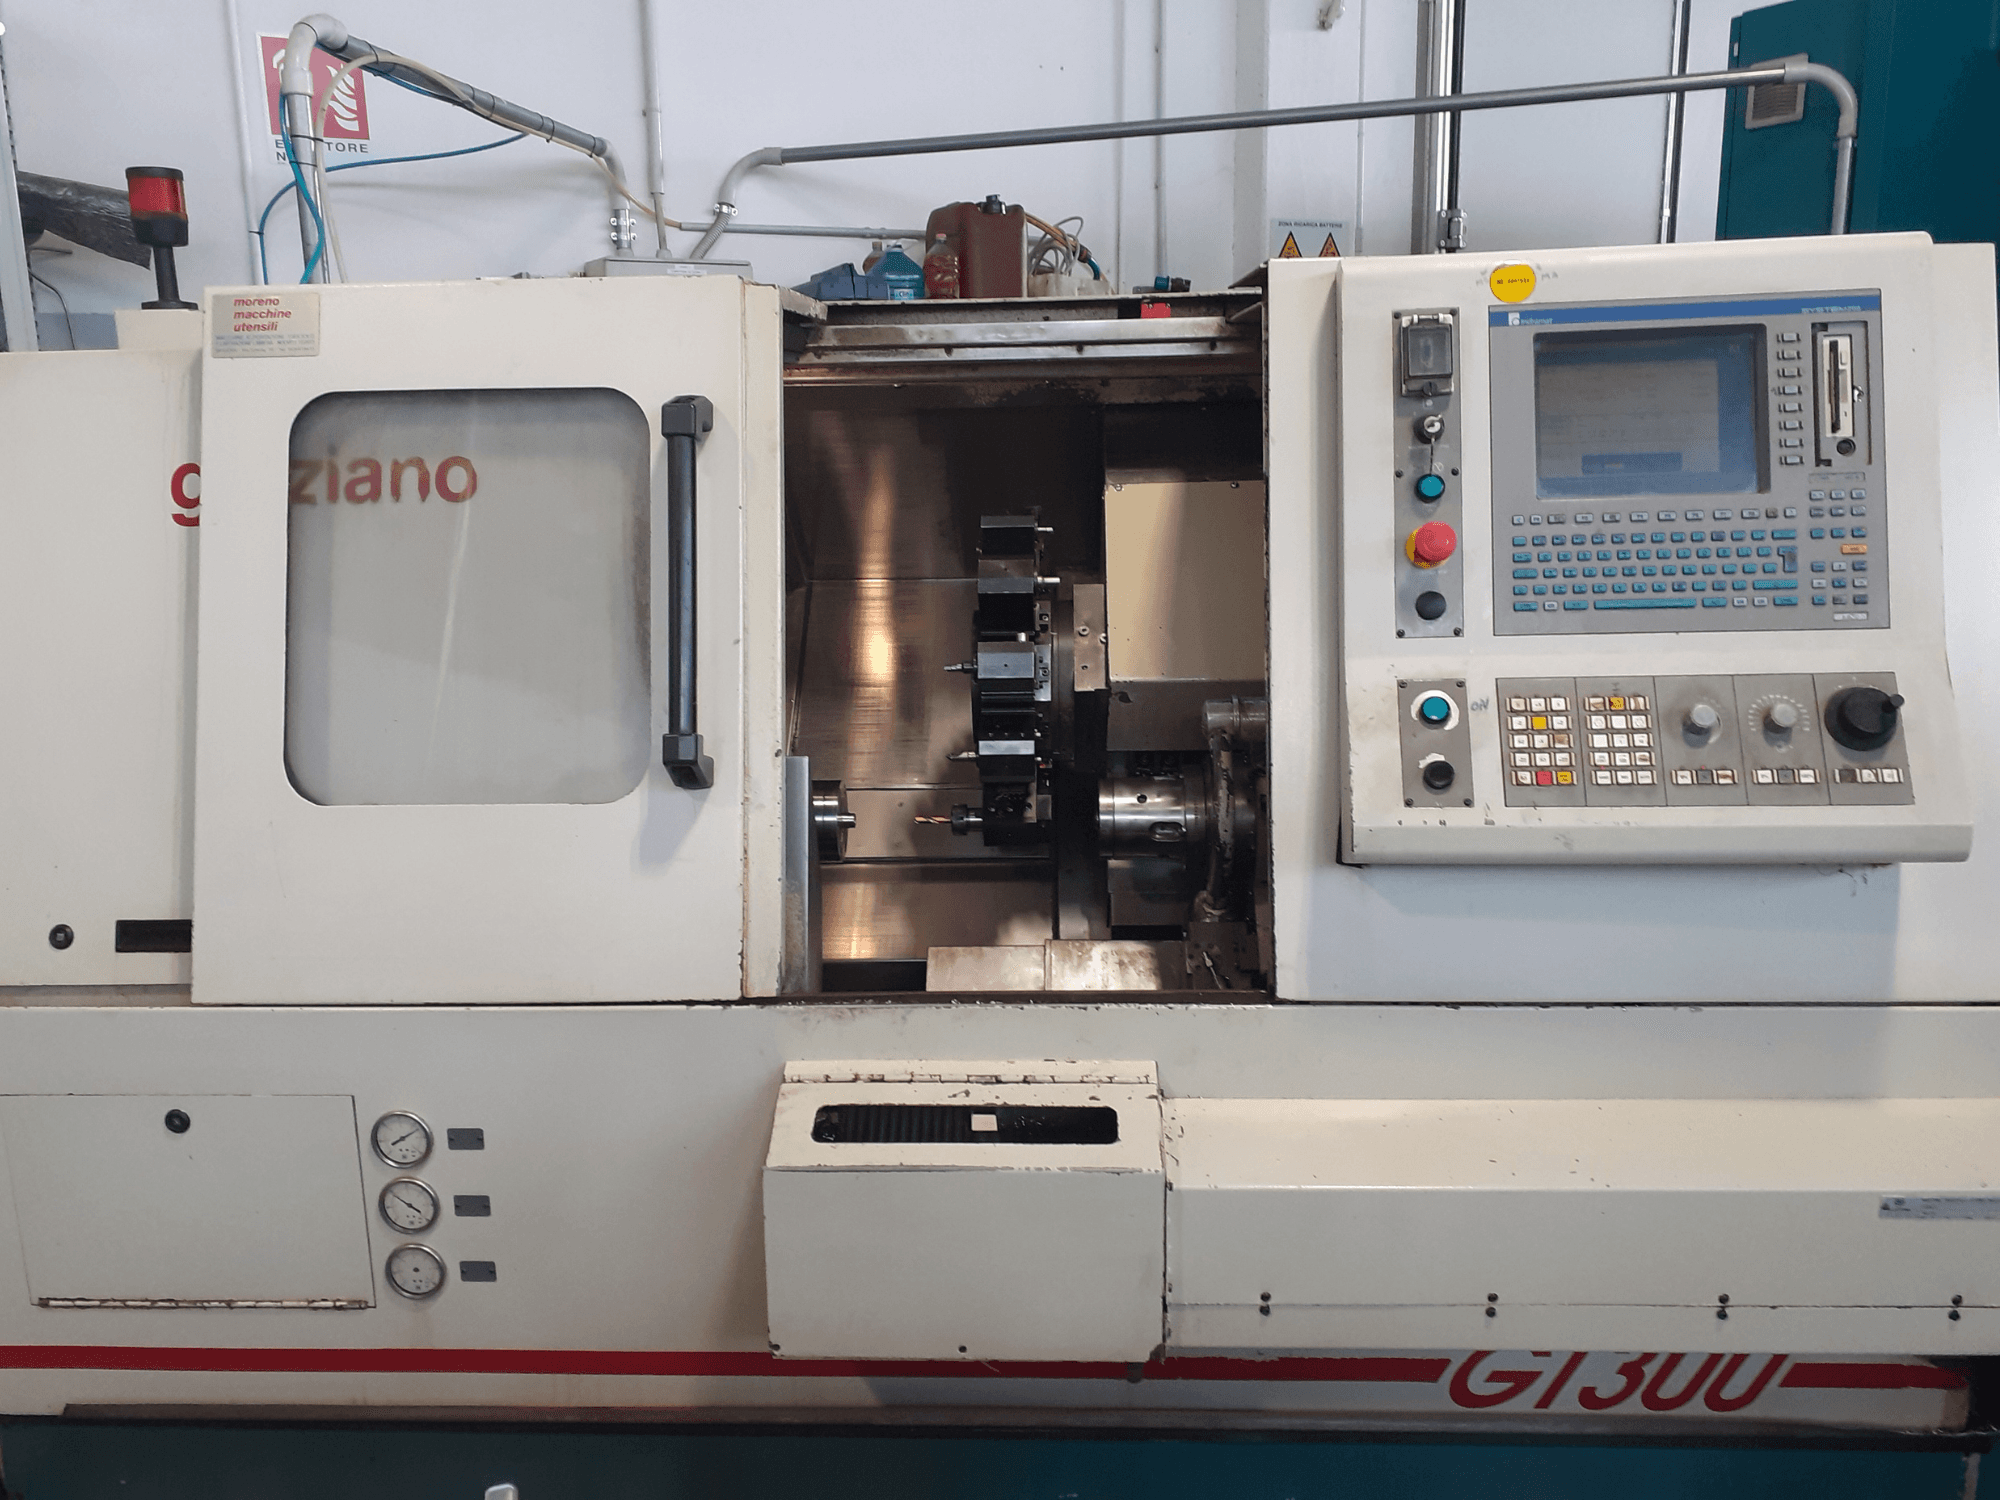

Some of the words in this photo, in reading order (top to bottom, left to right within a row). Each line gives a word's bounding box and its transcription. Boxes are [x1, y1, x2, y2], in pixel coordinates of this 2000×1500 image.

[233, 298, 280, 307] moreno
[233, 309, 292, 320] macchine
[233, 321, 279, 332] utensili
